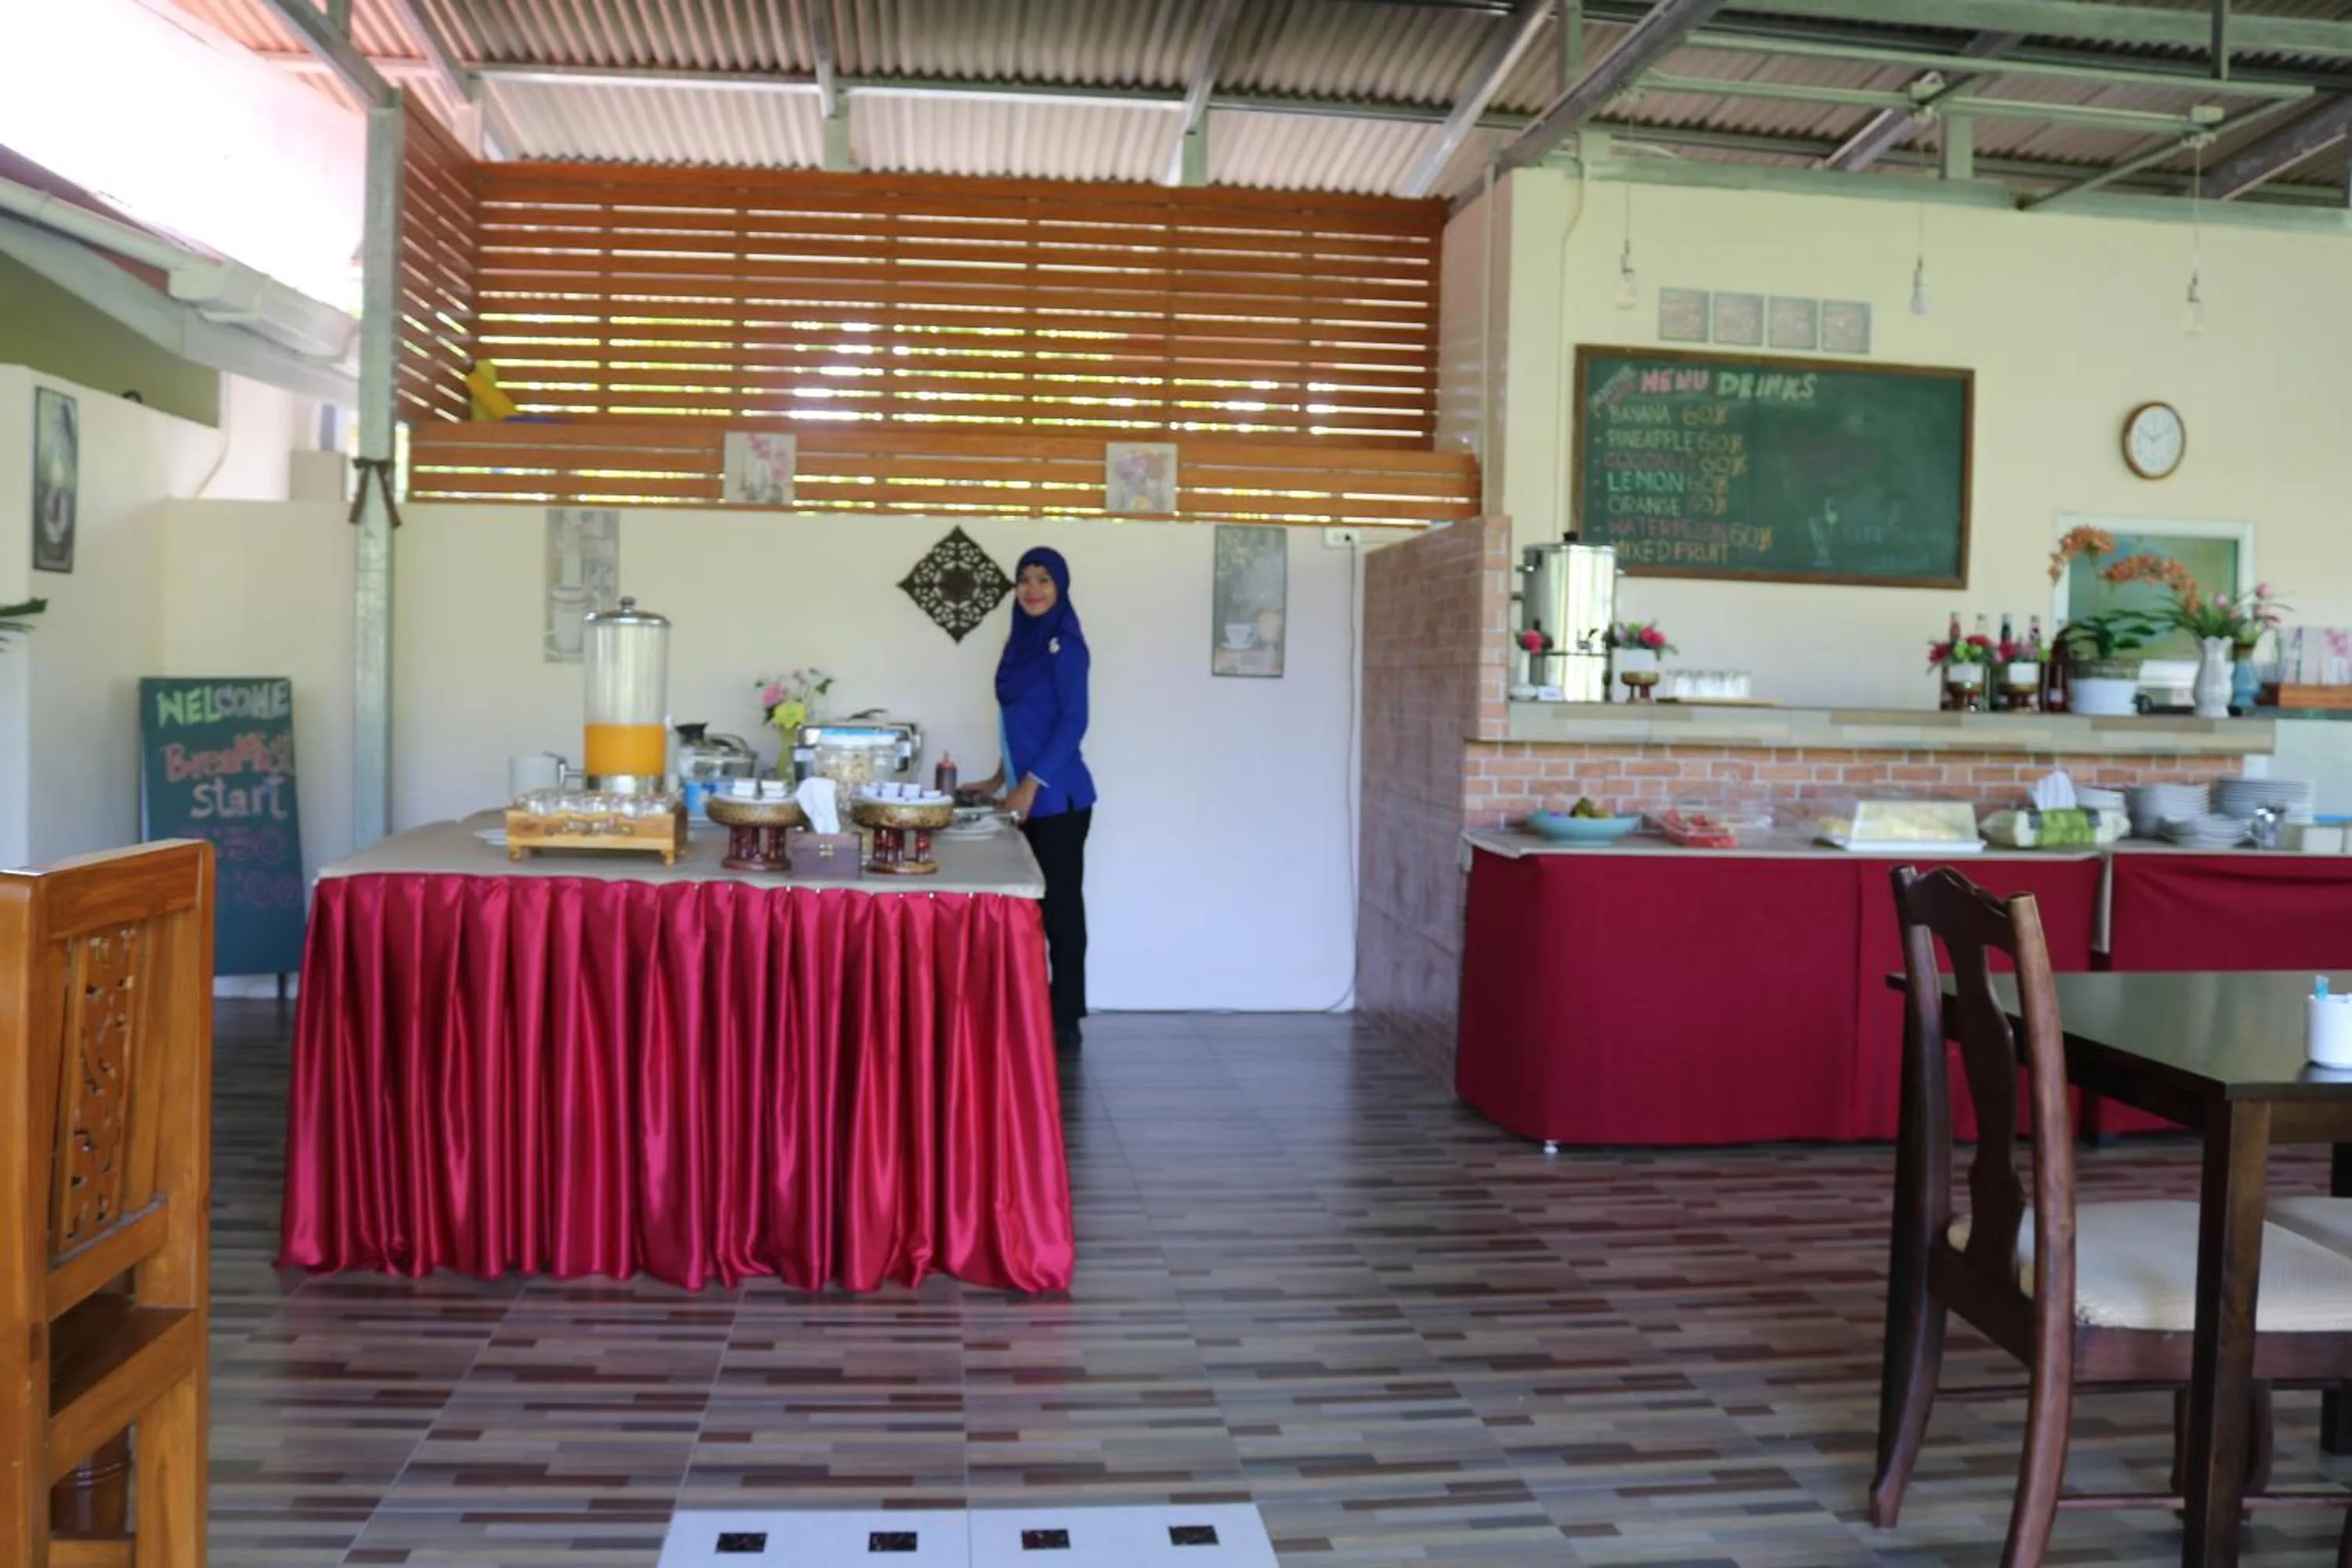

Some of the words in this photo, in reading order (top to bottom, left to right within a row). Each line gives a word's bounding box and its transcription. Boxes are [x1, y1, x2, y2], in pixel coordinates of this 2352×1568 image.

[1640, 367, 1711, 393] MENU
[1716, 370, 1818, 401] DRINKS
[1607, 470, 1685, 493] LEMON
[1607, 494, 1682, 517] ORANGE
[1612, 538, 1671, 563] MIXED
[1674, 541, 1728, 565] FRUIT
[156, 680, 289, 728] WELCOME
[190, 771, 289, 820] Start
